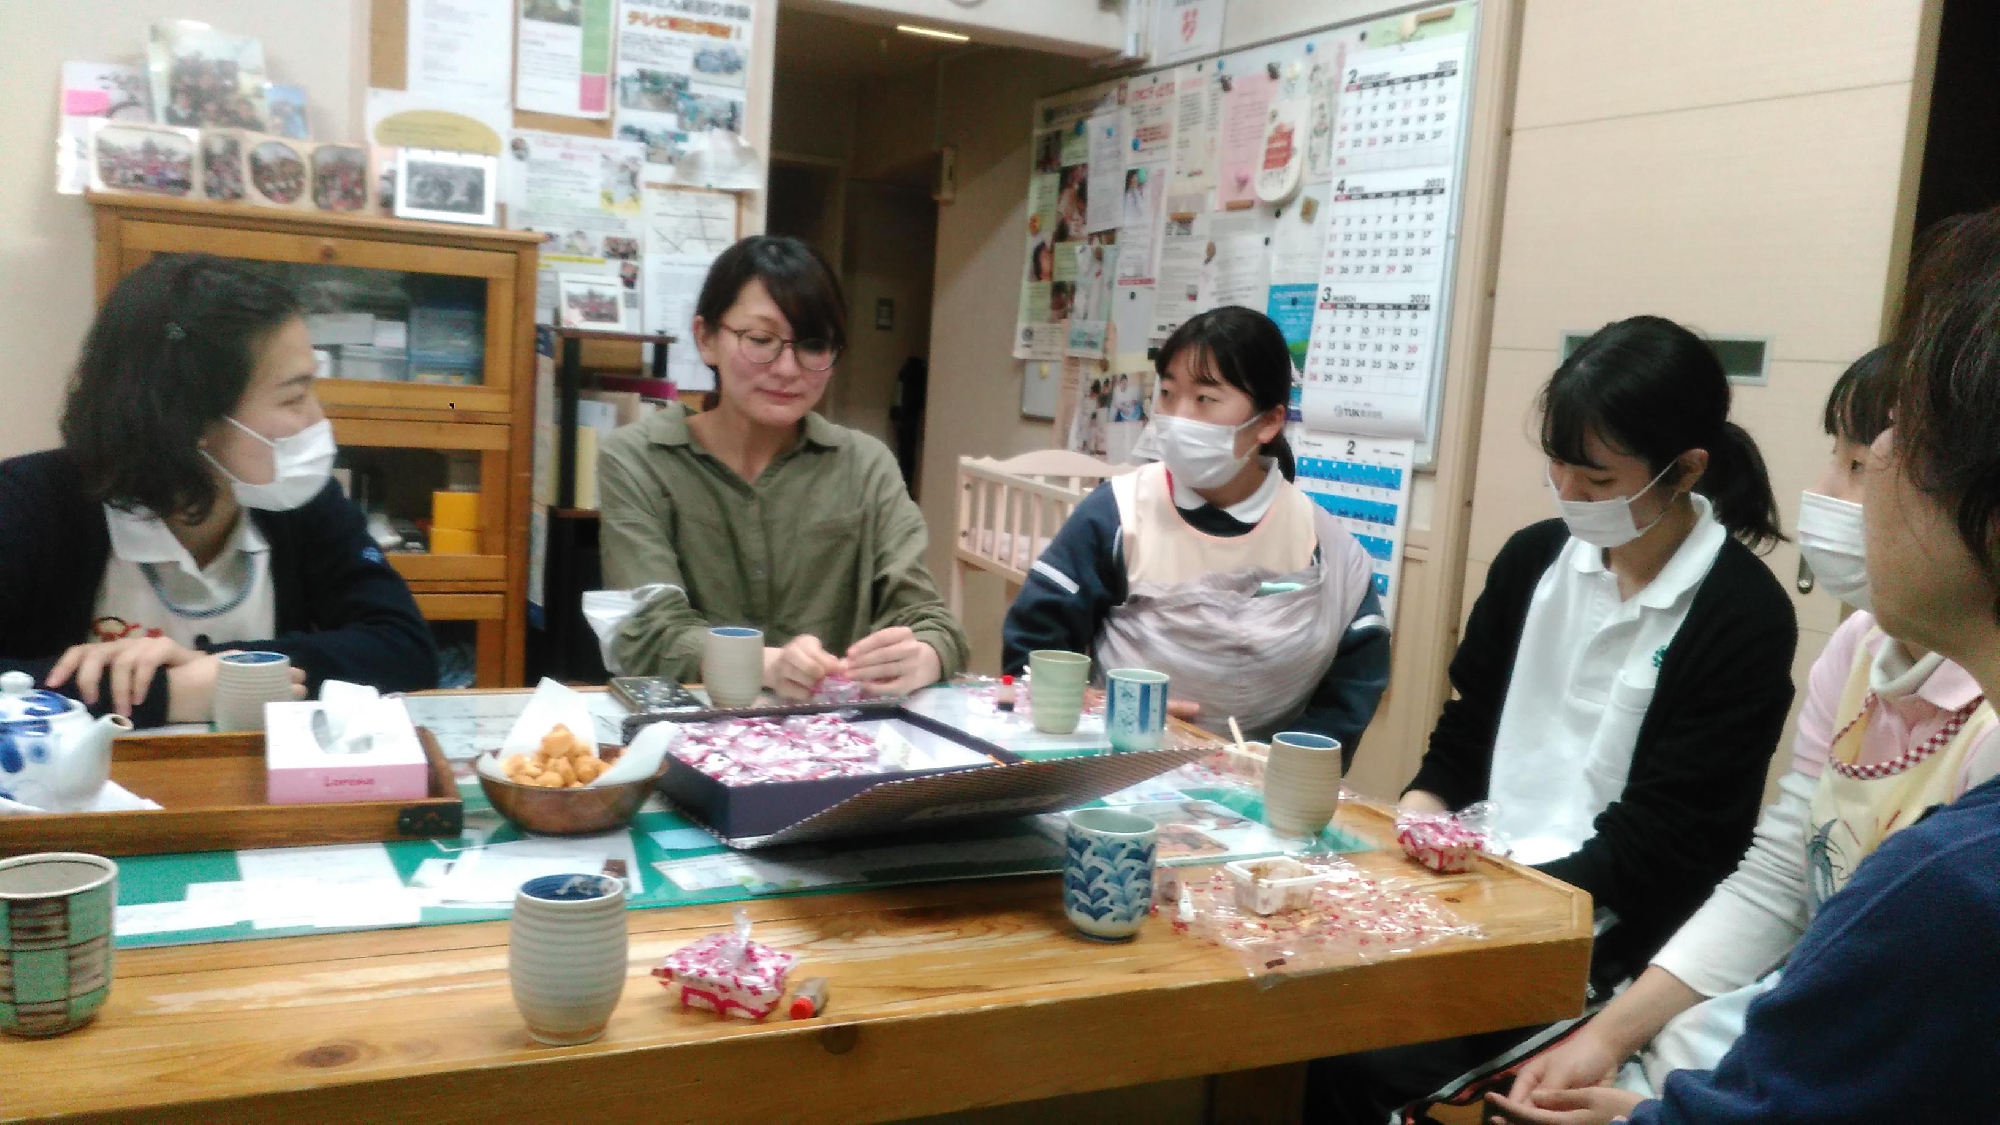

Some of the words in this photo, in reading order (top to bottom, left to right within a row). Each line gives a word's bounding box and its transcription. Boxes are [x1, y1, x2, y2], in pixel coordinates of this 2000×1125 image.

[1349, 69, 1357, 83] 2
[1438, 60, 1457, 70] 2021
[1389, 102, 1396, 110] 10
[1421, 98, 1428, 106] 12
[1437, 96, 1446, 104] 13
[1435, 113, 1446, 121] 20
[1368, 137, 1376, 146] 23
[1400, 134, 1408, 142] 25
[1433, 131, 1443, 139] 27
[1337, 180, 1345, 192] 4
[1425, 178, 1444, 187] 2021
[1411, 197, 1416, 205] 2
[1428, 196, 1432, 204] 3
[1426, 213, 1434, 221] 10
[1387, 265, 1396, 273] 29
[1403, 265, 1412, 273] 30
[1323, 287, 1331, 301] 3
[1362, 327, 1369, 335] 10
[1346, 441, 1356, 455] 2
